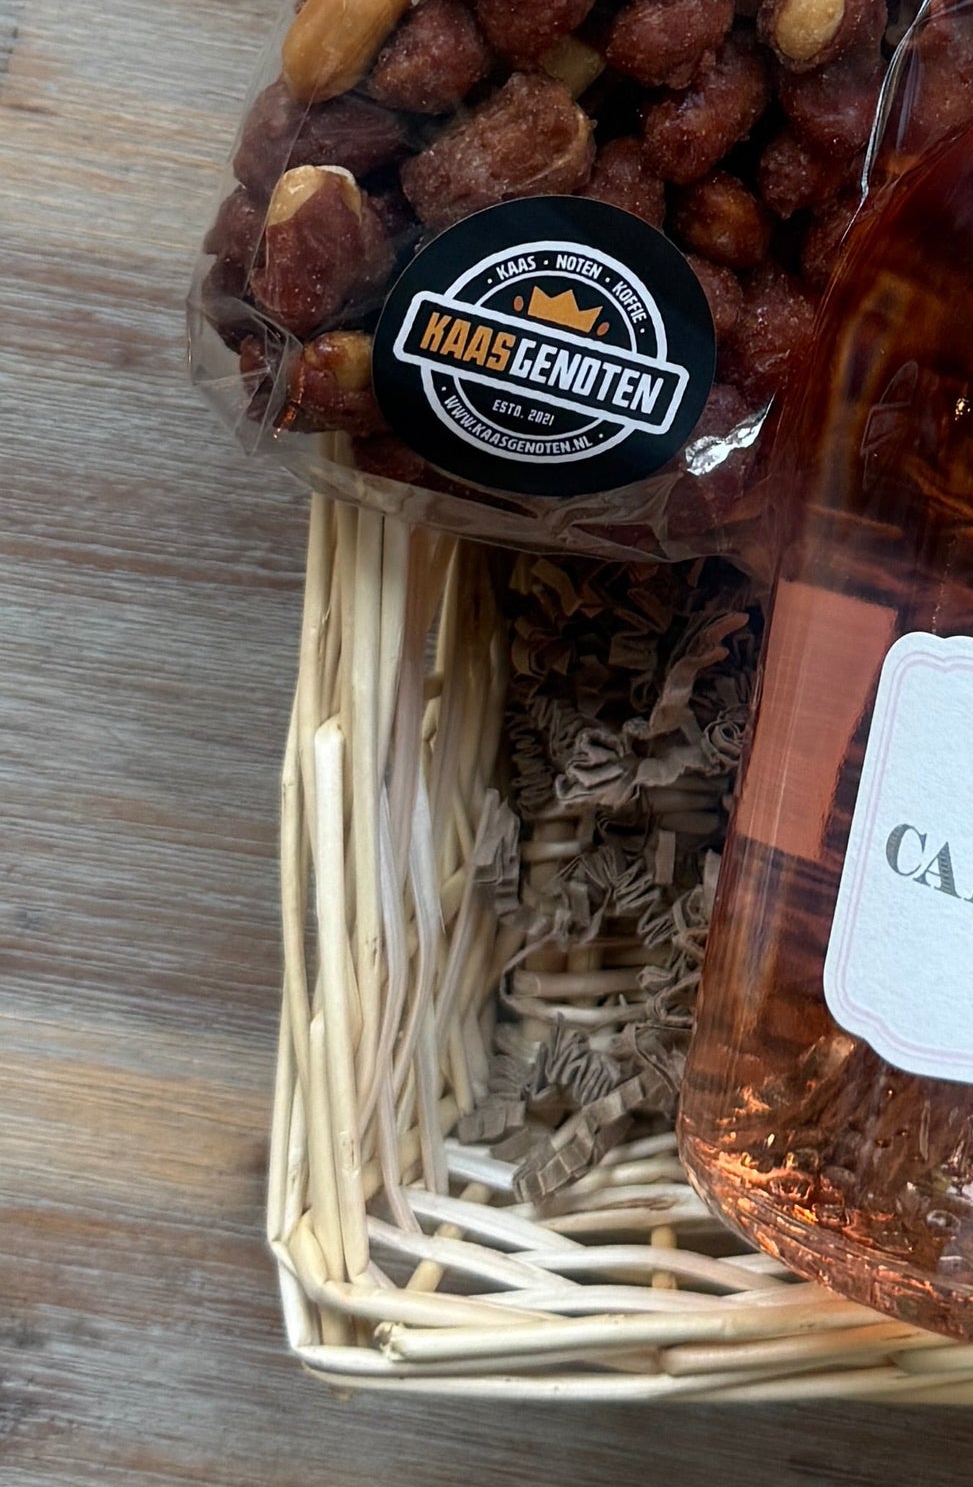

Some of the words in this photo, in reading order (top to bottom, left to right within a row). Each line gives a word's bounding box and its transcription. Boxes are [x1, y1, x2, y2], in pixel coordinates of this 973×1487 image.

[496, 255, 537, 280] KAAS
[556, 254, 603, 279] NOTEN
[612, 280, 648, 324] KOFFIE
[420, 311, 664, 414] KAASGENOTEN
[444, 395, 593, 454] WWW.KAASGENOTEN.NL
[528, 409, 555, 426] 2021
